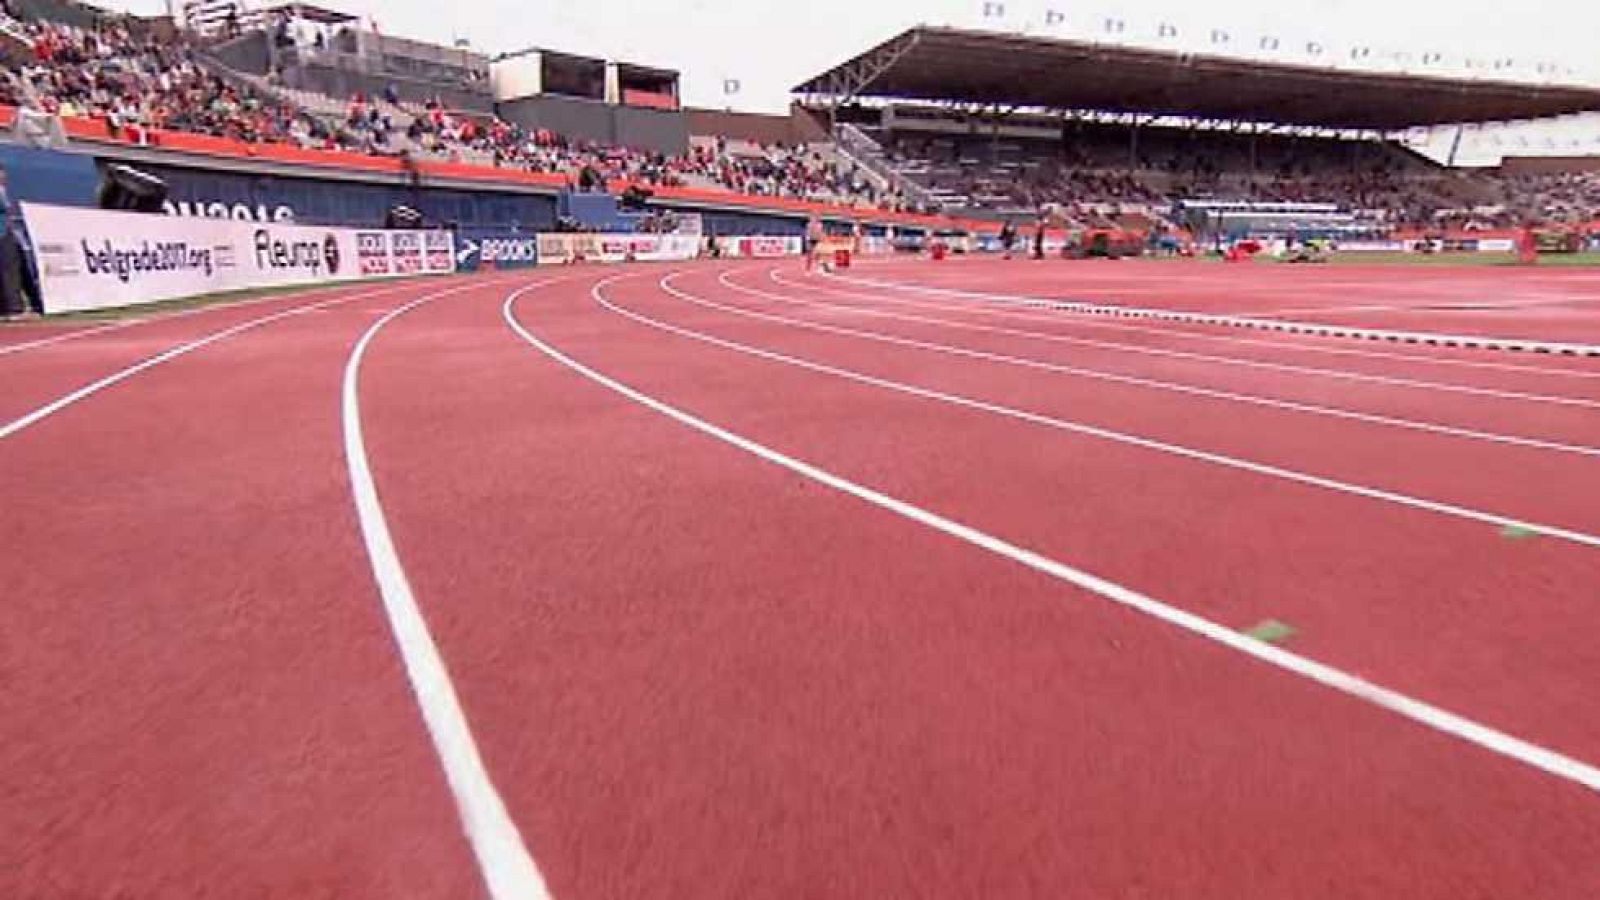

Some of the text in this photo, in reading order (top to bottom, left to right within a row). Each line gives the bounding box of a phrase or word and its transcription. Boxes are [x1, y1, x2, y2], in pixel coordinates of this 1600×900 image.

[81, 238, 212, 283] belgrade2017.org
[255, 229, 320, 277] Fleurop
[482, 239, 536, 261] BROOKS
